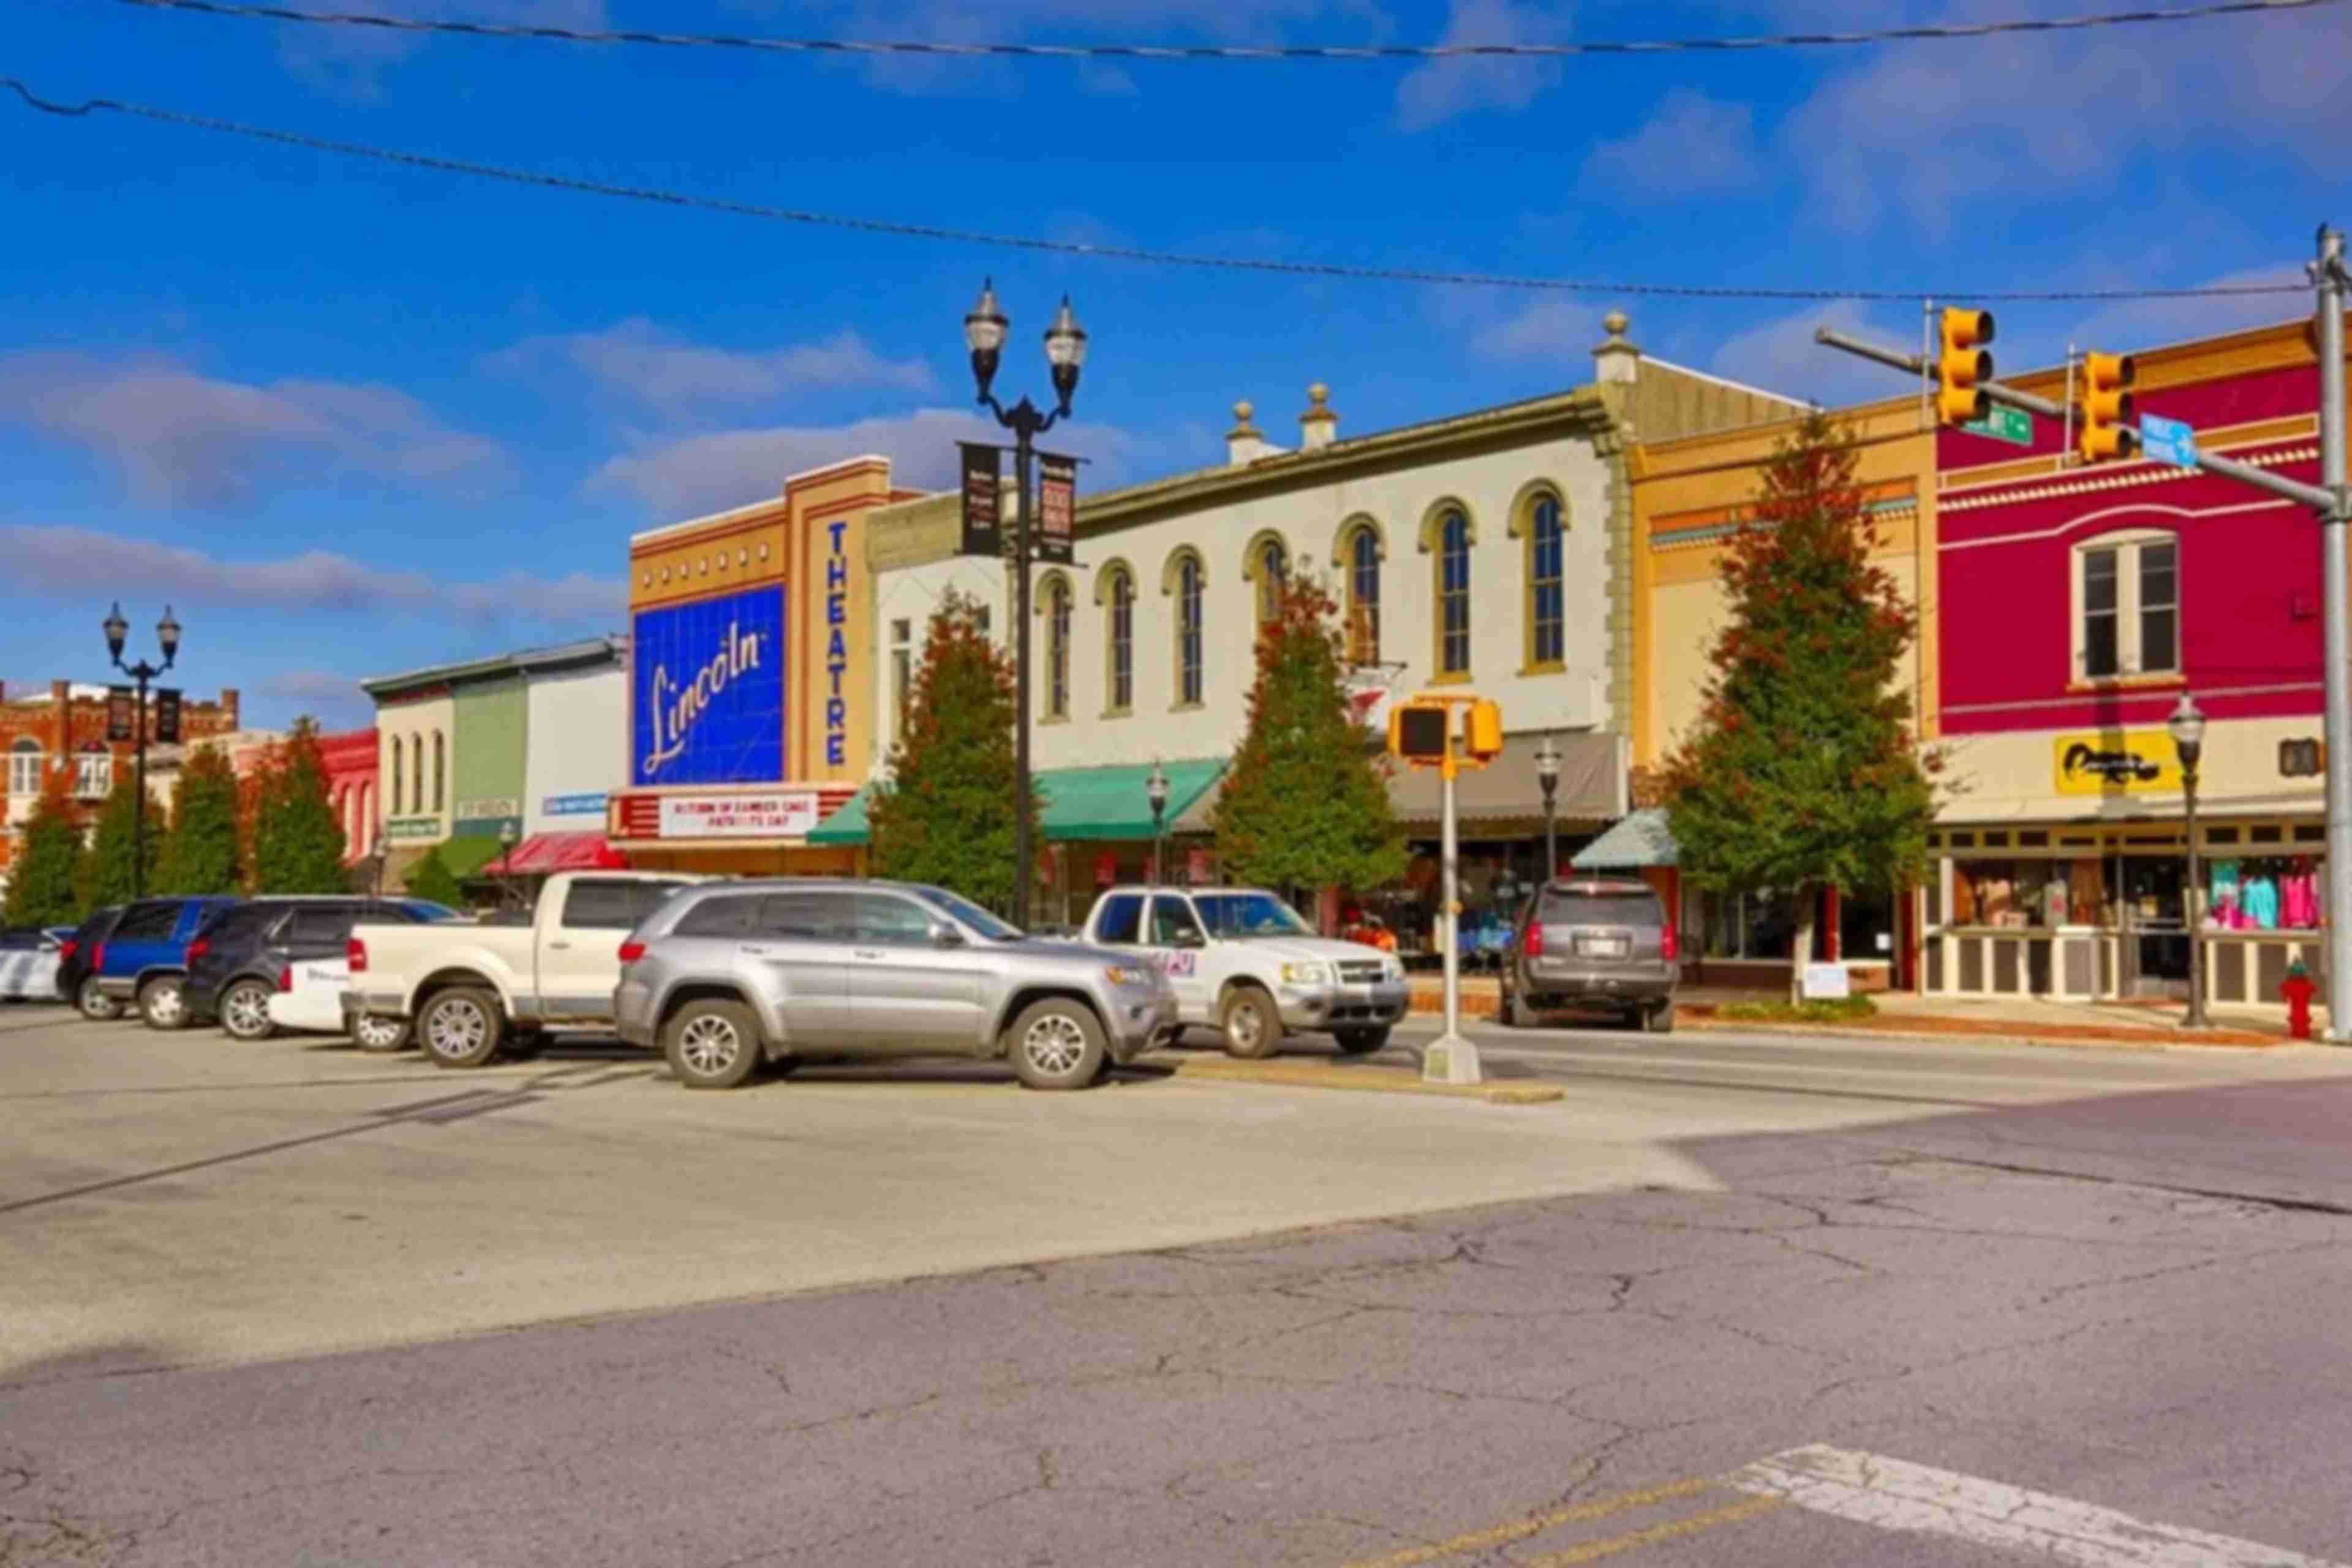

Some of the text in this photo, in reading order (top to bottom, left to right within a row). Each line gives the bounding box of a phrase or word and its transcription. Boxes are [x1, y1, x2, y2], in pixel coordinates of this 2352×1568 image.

[644, 620, 760, 775] Lincoln
[827, 522, 846, 766] THEATRE
[709, 815, 763, 826] PATRTS
